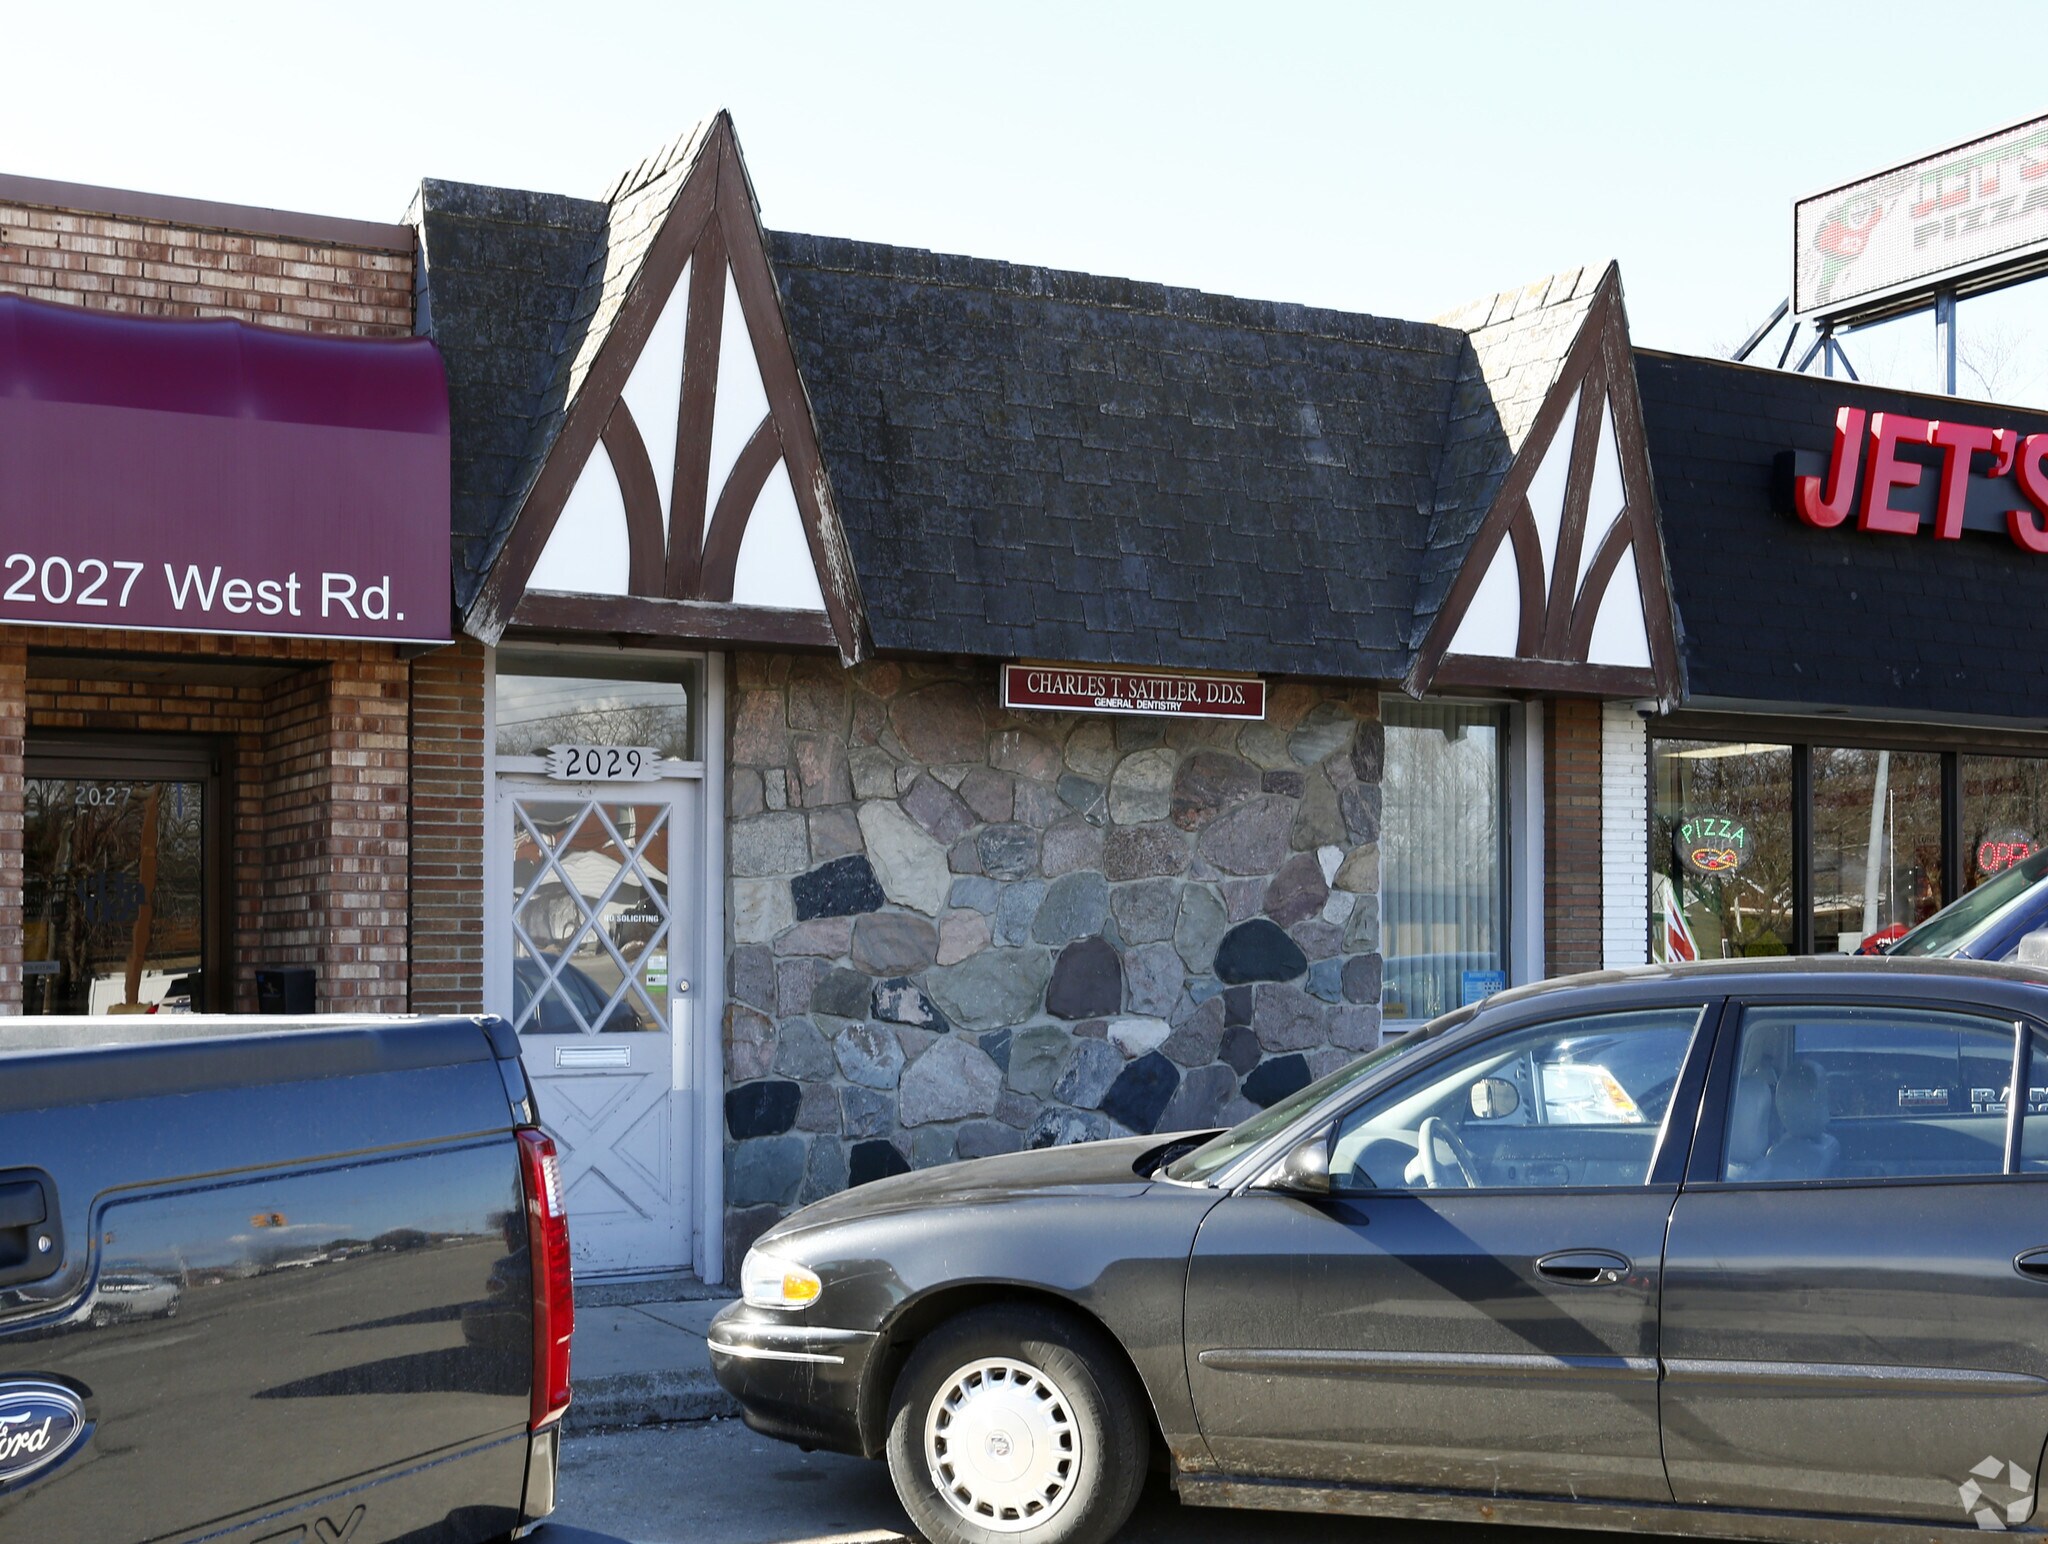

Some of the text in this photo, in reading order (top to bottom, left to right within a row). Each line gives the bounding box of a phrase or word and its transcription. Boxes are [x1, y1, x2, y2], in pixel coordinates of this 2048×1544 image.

[1794, 406, 2048, 553] JET'S
[3, 553, 405, 621] 2027 West Rd.
[1027, 672, 1246, 705] CHARLES T. SATTLER, D.D.S.
[1094, 697, 1182, 712] GENERAL DENTISTRY
[566, 748, 642, 778] 2029
[75, 786, 131, 808] 2027
[1681, 818, 1744, 849] PIZZA
[616, 914, 659, 923] SOLICITING
